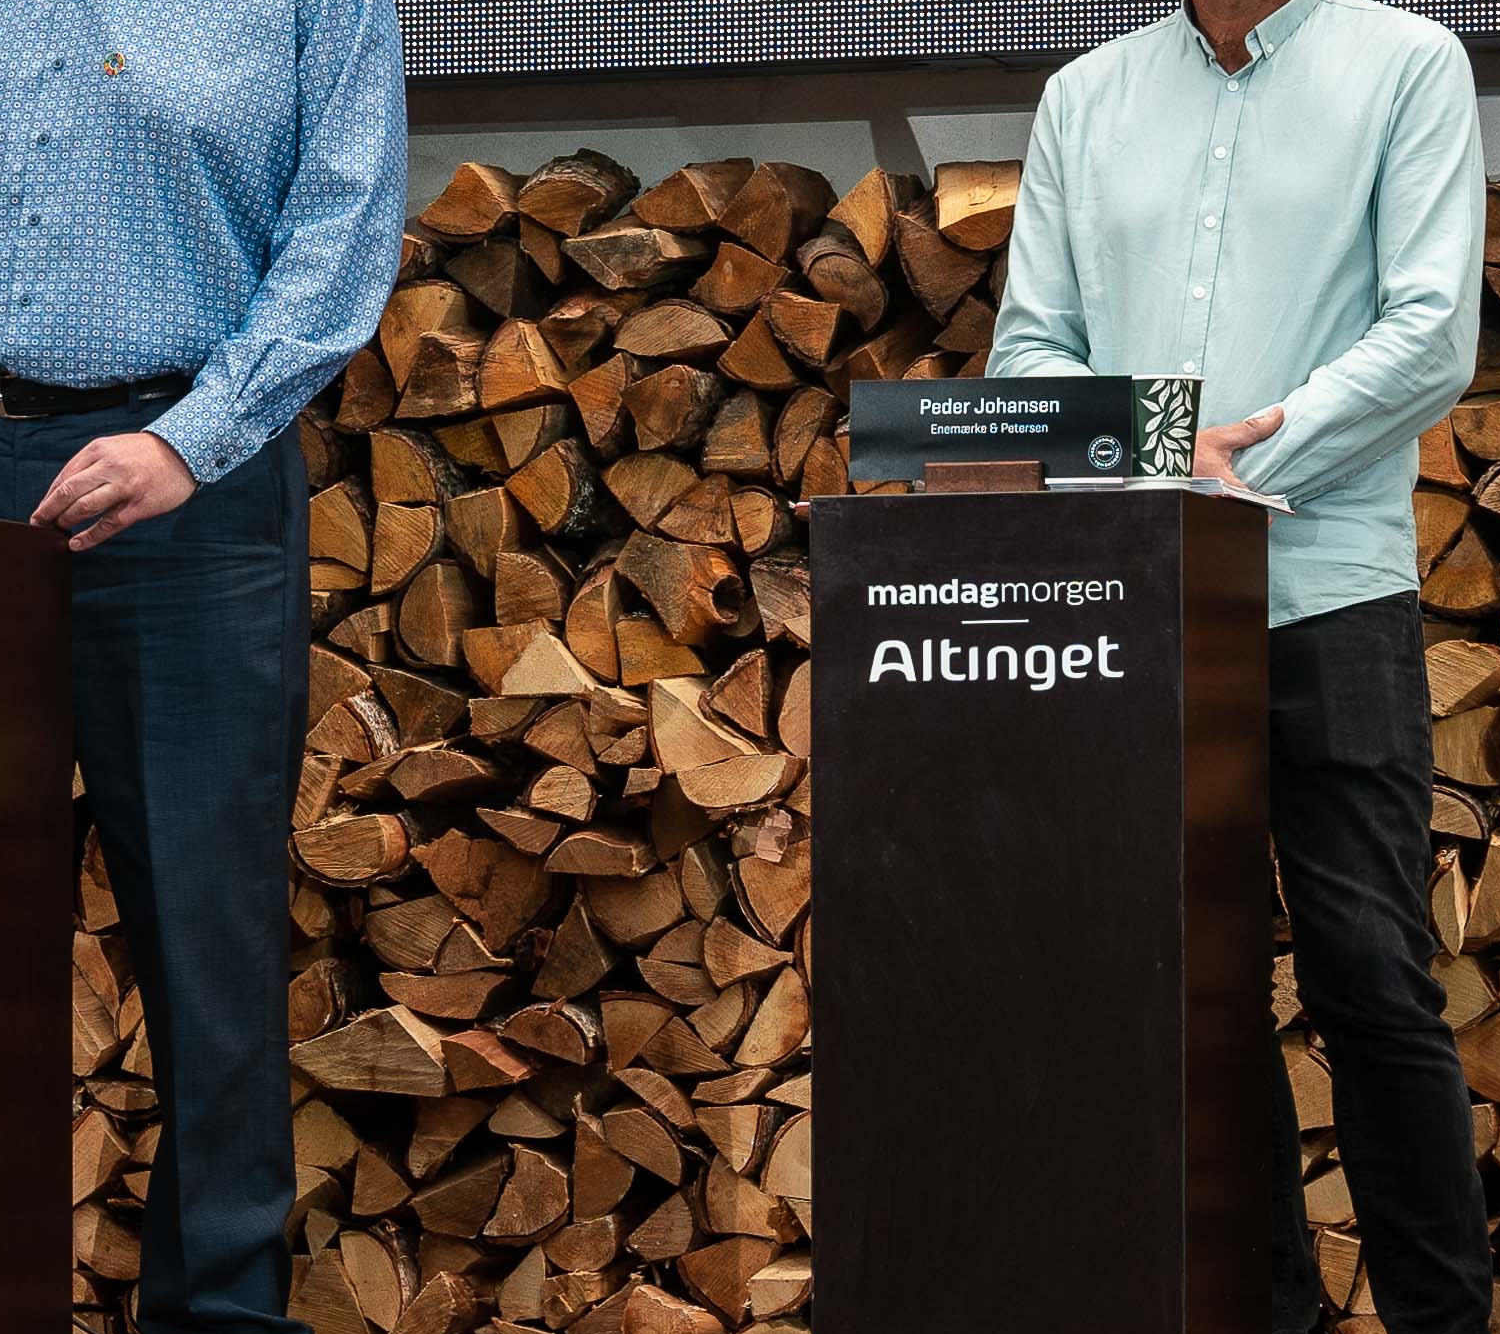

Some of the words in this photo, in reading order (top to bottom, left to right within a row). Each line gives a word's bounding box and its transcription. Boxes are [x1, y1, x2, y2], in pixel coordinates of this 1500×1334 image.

[919, 398, 971, 416] Peder
[973, 396, 1060, 415] Johansen
[930, 423, 988, 435] Enemærke
[989, 422, 998, 434] &
[1000, 421, 1049, 434] Petersen
[867, 578, 1124, 609] mandagmorgen
[868, 635, 1125, 692] Altinget
